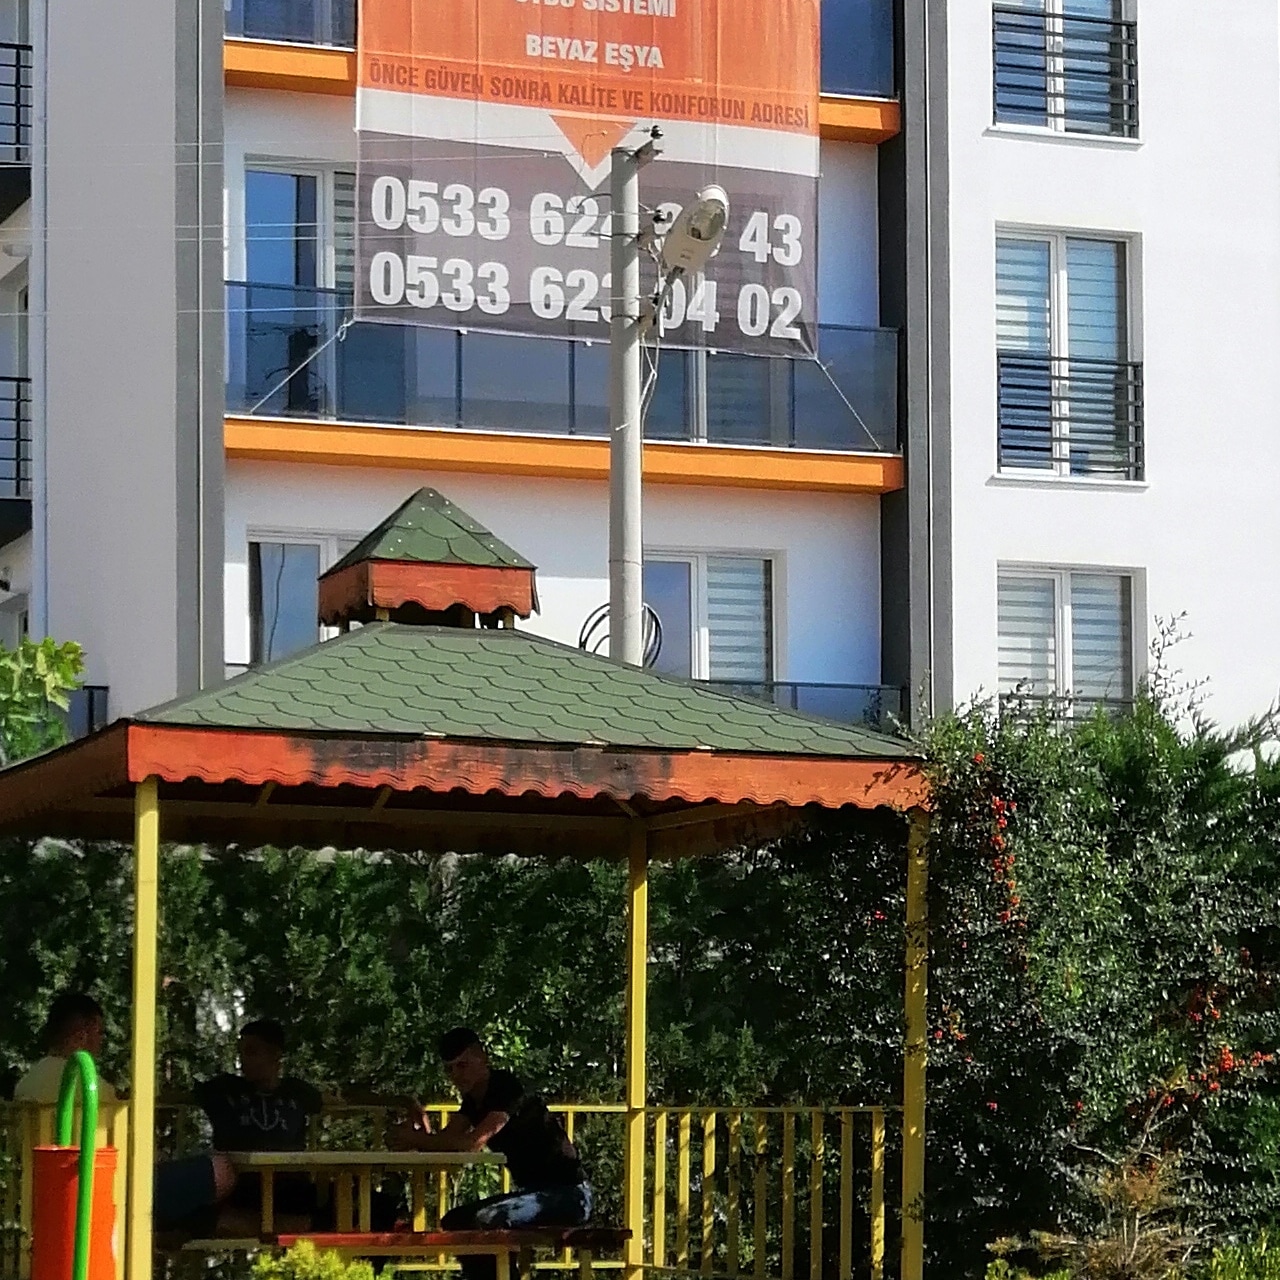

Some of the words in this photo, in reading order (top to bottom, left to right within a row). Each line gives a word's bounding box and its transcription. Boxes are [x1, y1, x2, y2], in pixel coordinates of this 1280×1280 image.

[526, 33, 598, 64] BEYAZ
[605, 42, 665, 73] EŞYA
[369, 58, 419, 87] ÖNCE
[424, 65, 484, 95] GÜVEN
[489, 75, 552, 102] SONRA
[557, 82, 617, 108] KALİTE
[622, 89, 644, 111] VE
[649, 90, 746, 120] KONFORUN
[750, 100, 810, 129] ADRESİ
[371, 175, 511, 241] 0533
[738, 211, 803, 267] 43
[369, 251, 511, 316] 0533
[737, 283, 802, 341] 02
